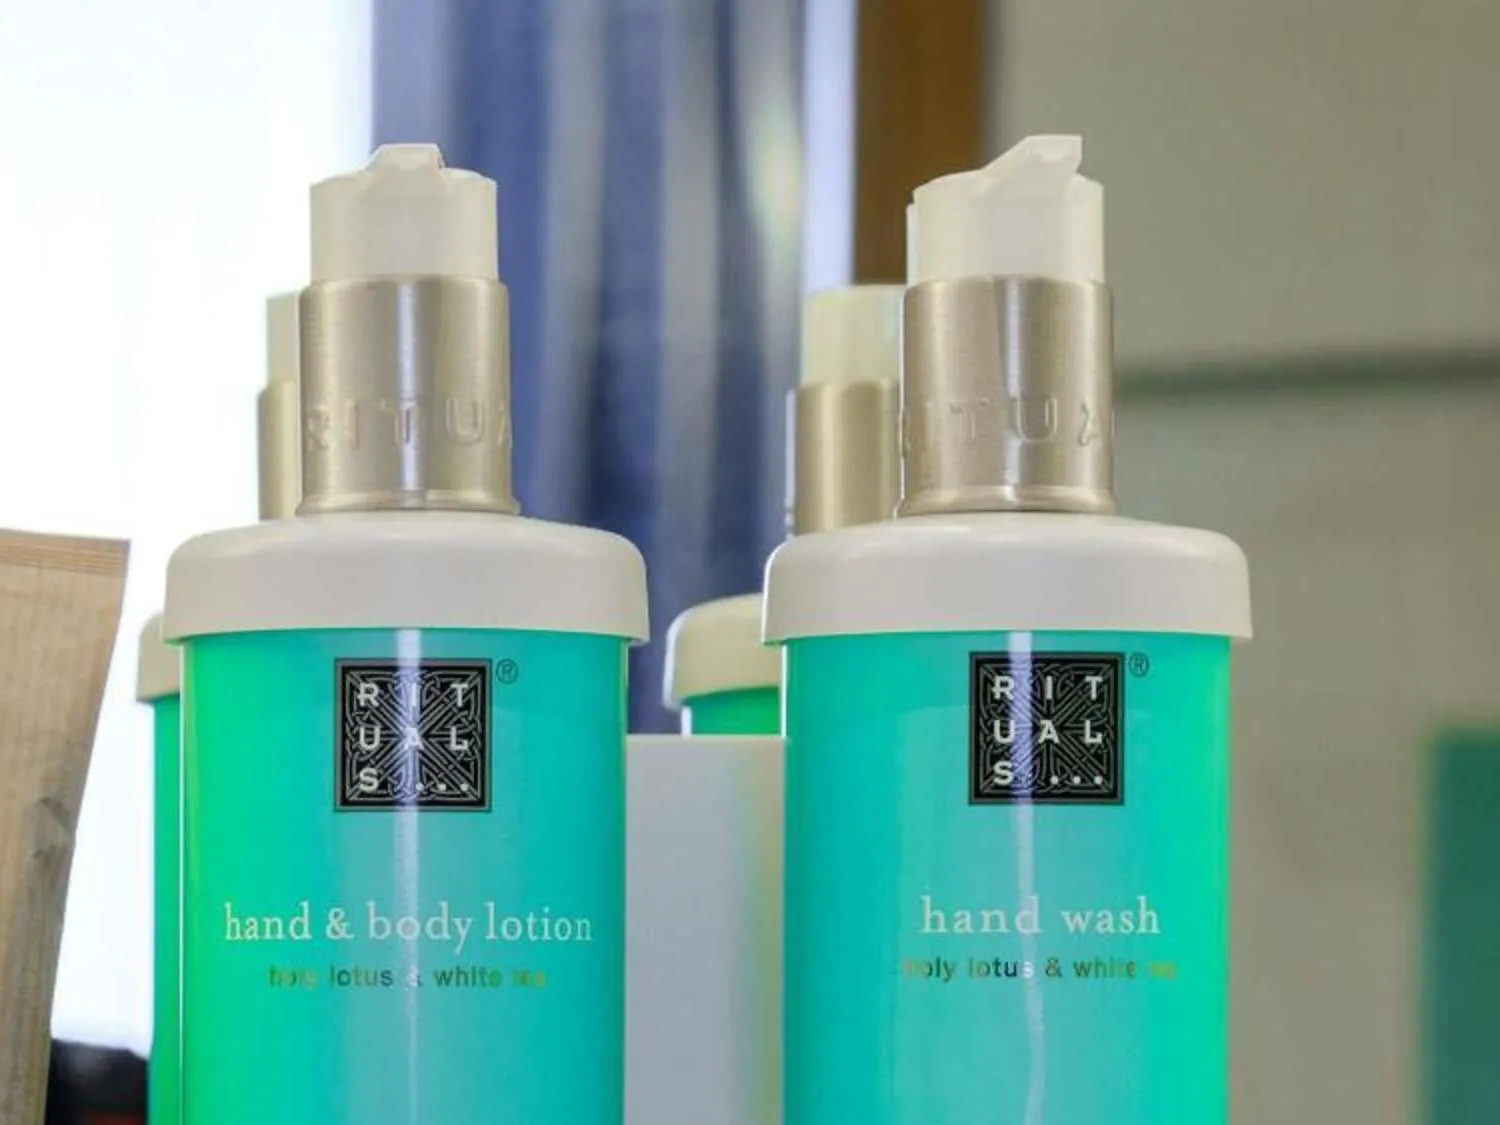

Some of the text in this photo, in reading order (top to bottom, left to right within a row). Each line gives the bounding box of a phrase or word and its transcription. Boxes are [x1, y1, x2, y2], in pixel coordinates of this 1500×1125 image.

[224, 901, 592, 954] hand & body lotion
[920, 896, 1161, 935] hand wash
[329, 963, 393, 987] lotus
[968, 956, 1034, 979] lotus
[1045, 957, 1062, 978] &
